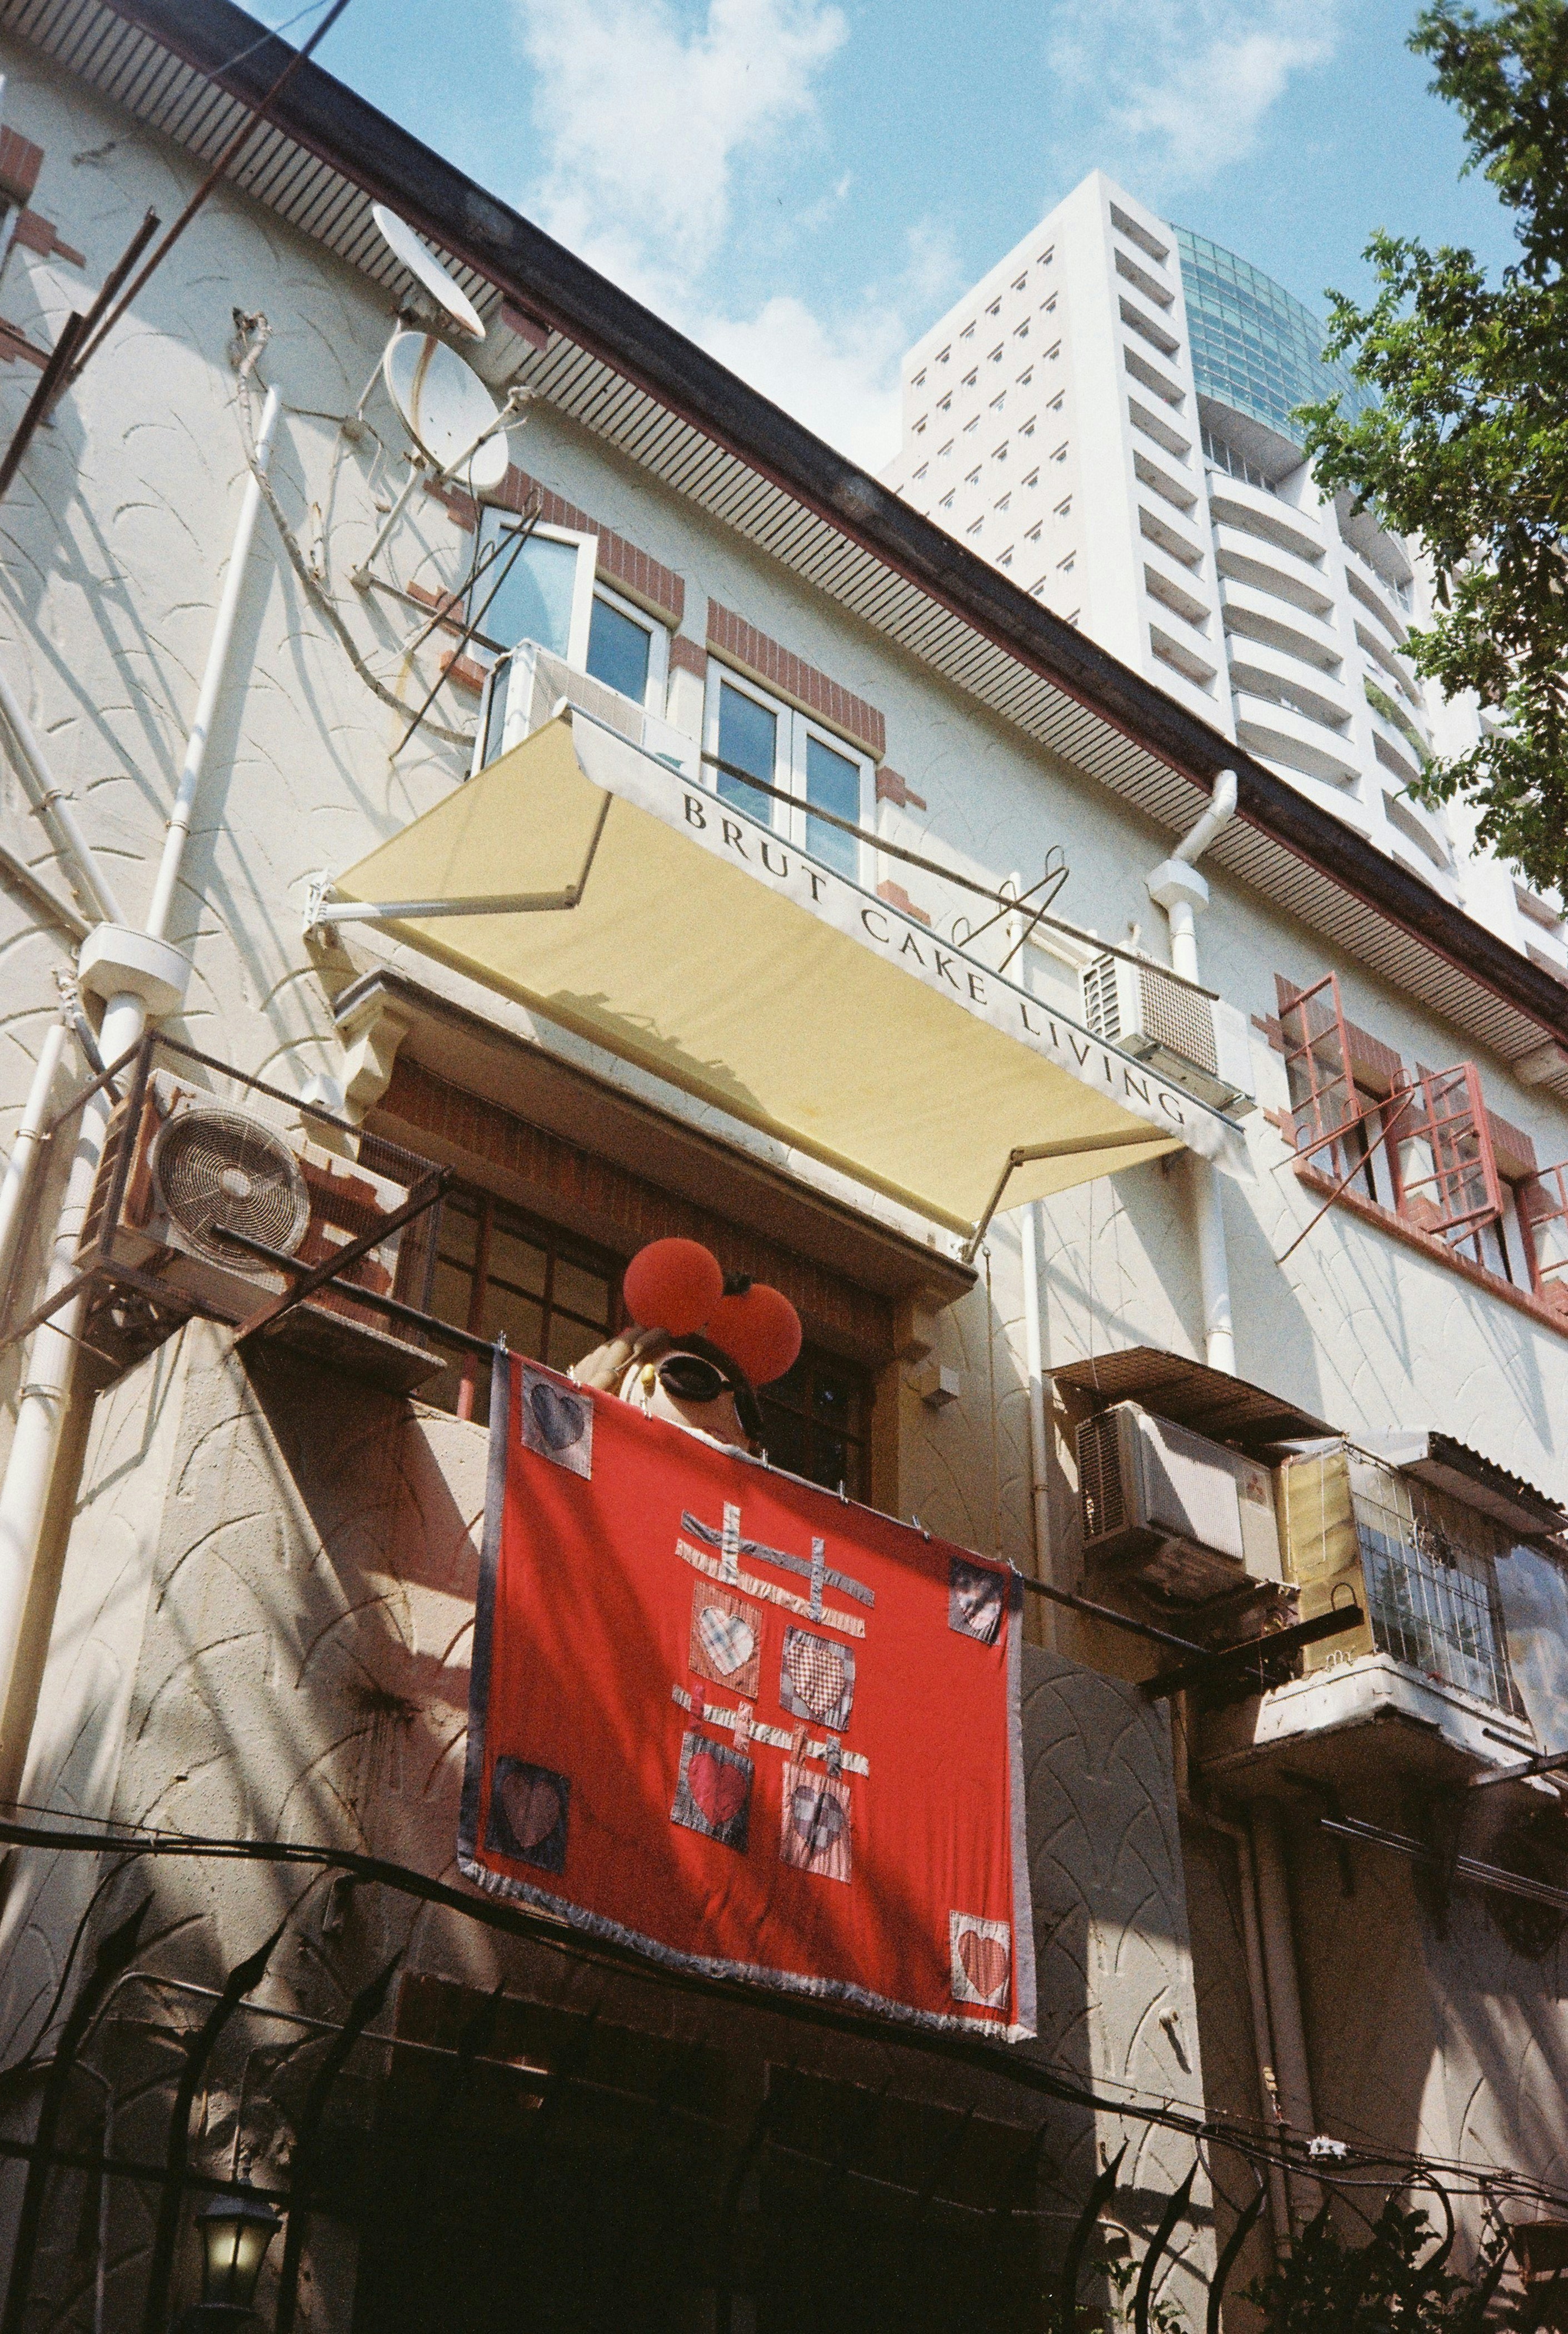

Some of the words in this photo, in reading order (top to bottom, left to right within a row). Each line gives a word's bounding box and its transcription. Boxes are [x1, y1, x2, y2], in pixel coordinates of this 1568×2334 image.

[683, 793, 827, 903] BRUT
[861, 909, 988, 1005] CAKE
[1019, 1004, 1185, 1125] LIVING
